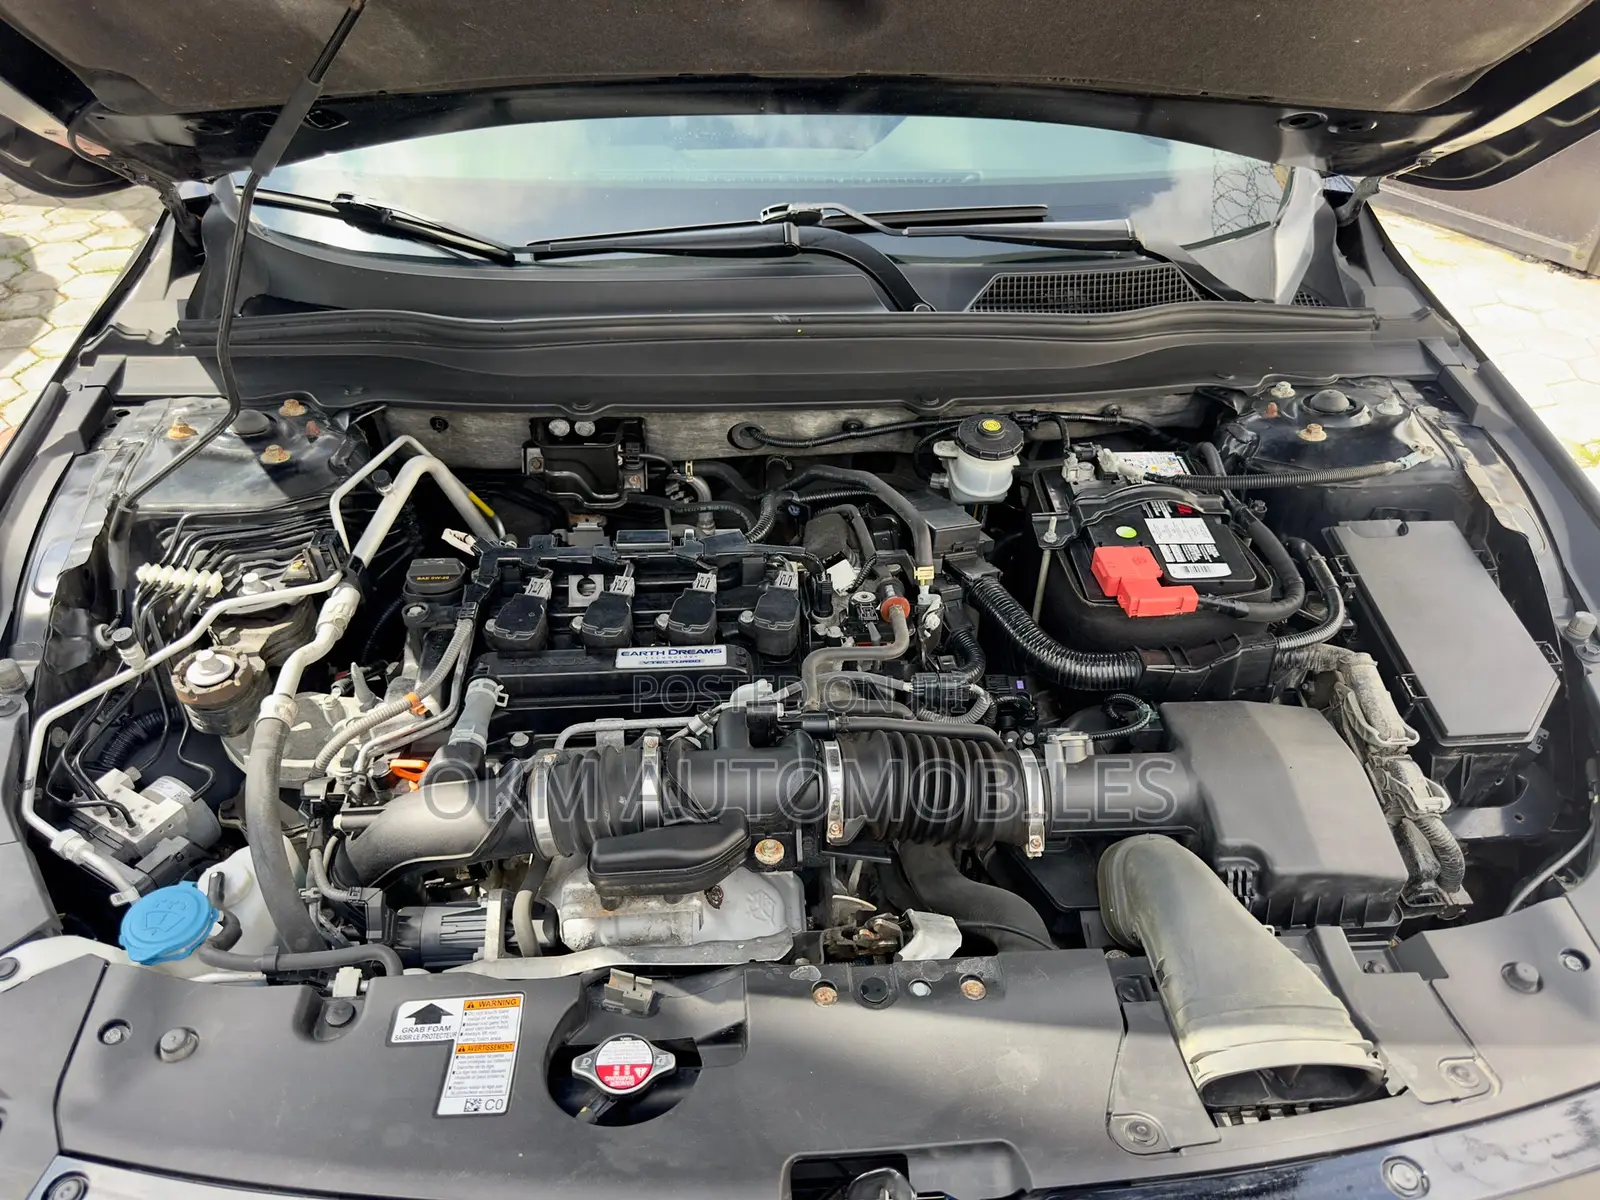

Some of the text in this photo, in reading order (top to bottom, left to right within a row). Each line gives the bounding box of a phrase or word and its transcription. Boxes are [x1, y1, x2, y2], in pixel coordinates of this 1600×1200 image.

[479, 998, 517, 1008] WARNING
[421, 1031, 458, 1040] PROTECTEUR
[466, 1043, 513, 1052] AVERTISSEMENT
